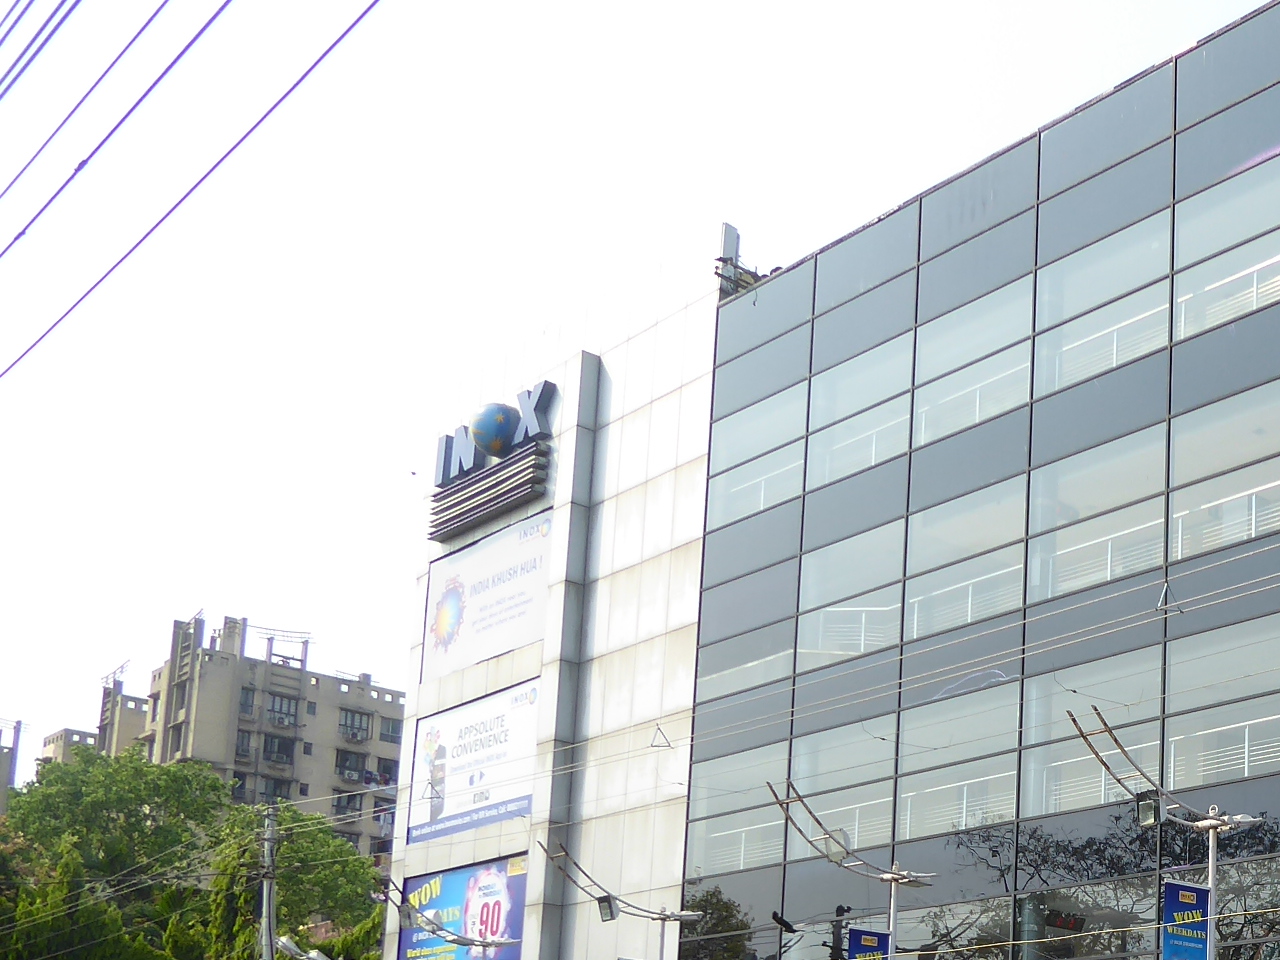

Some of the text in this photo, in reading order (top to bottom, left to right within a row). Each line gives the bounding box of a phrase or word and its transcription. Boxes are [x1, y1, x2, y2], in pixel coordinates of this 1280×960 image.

[434, 380, 561, 489] INOX
[470, 578, 490, 598] INDIA
[490, 564, 518, 590] KHUSH
[520, 558, 537, 576] HUA
[451, 729, 510, 758] CONVENIENCE
[458, 714, 506, 742] APPSOLUTE
[408, 874, 443, 909] WOW
[478, 900, 502, 938] 90
[1166, 926, 1206, 938] WEEKDAYS
[1173, 910, 1202, 924] WOW
